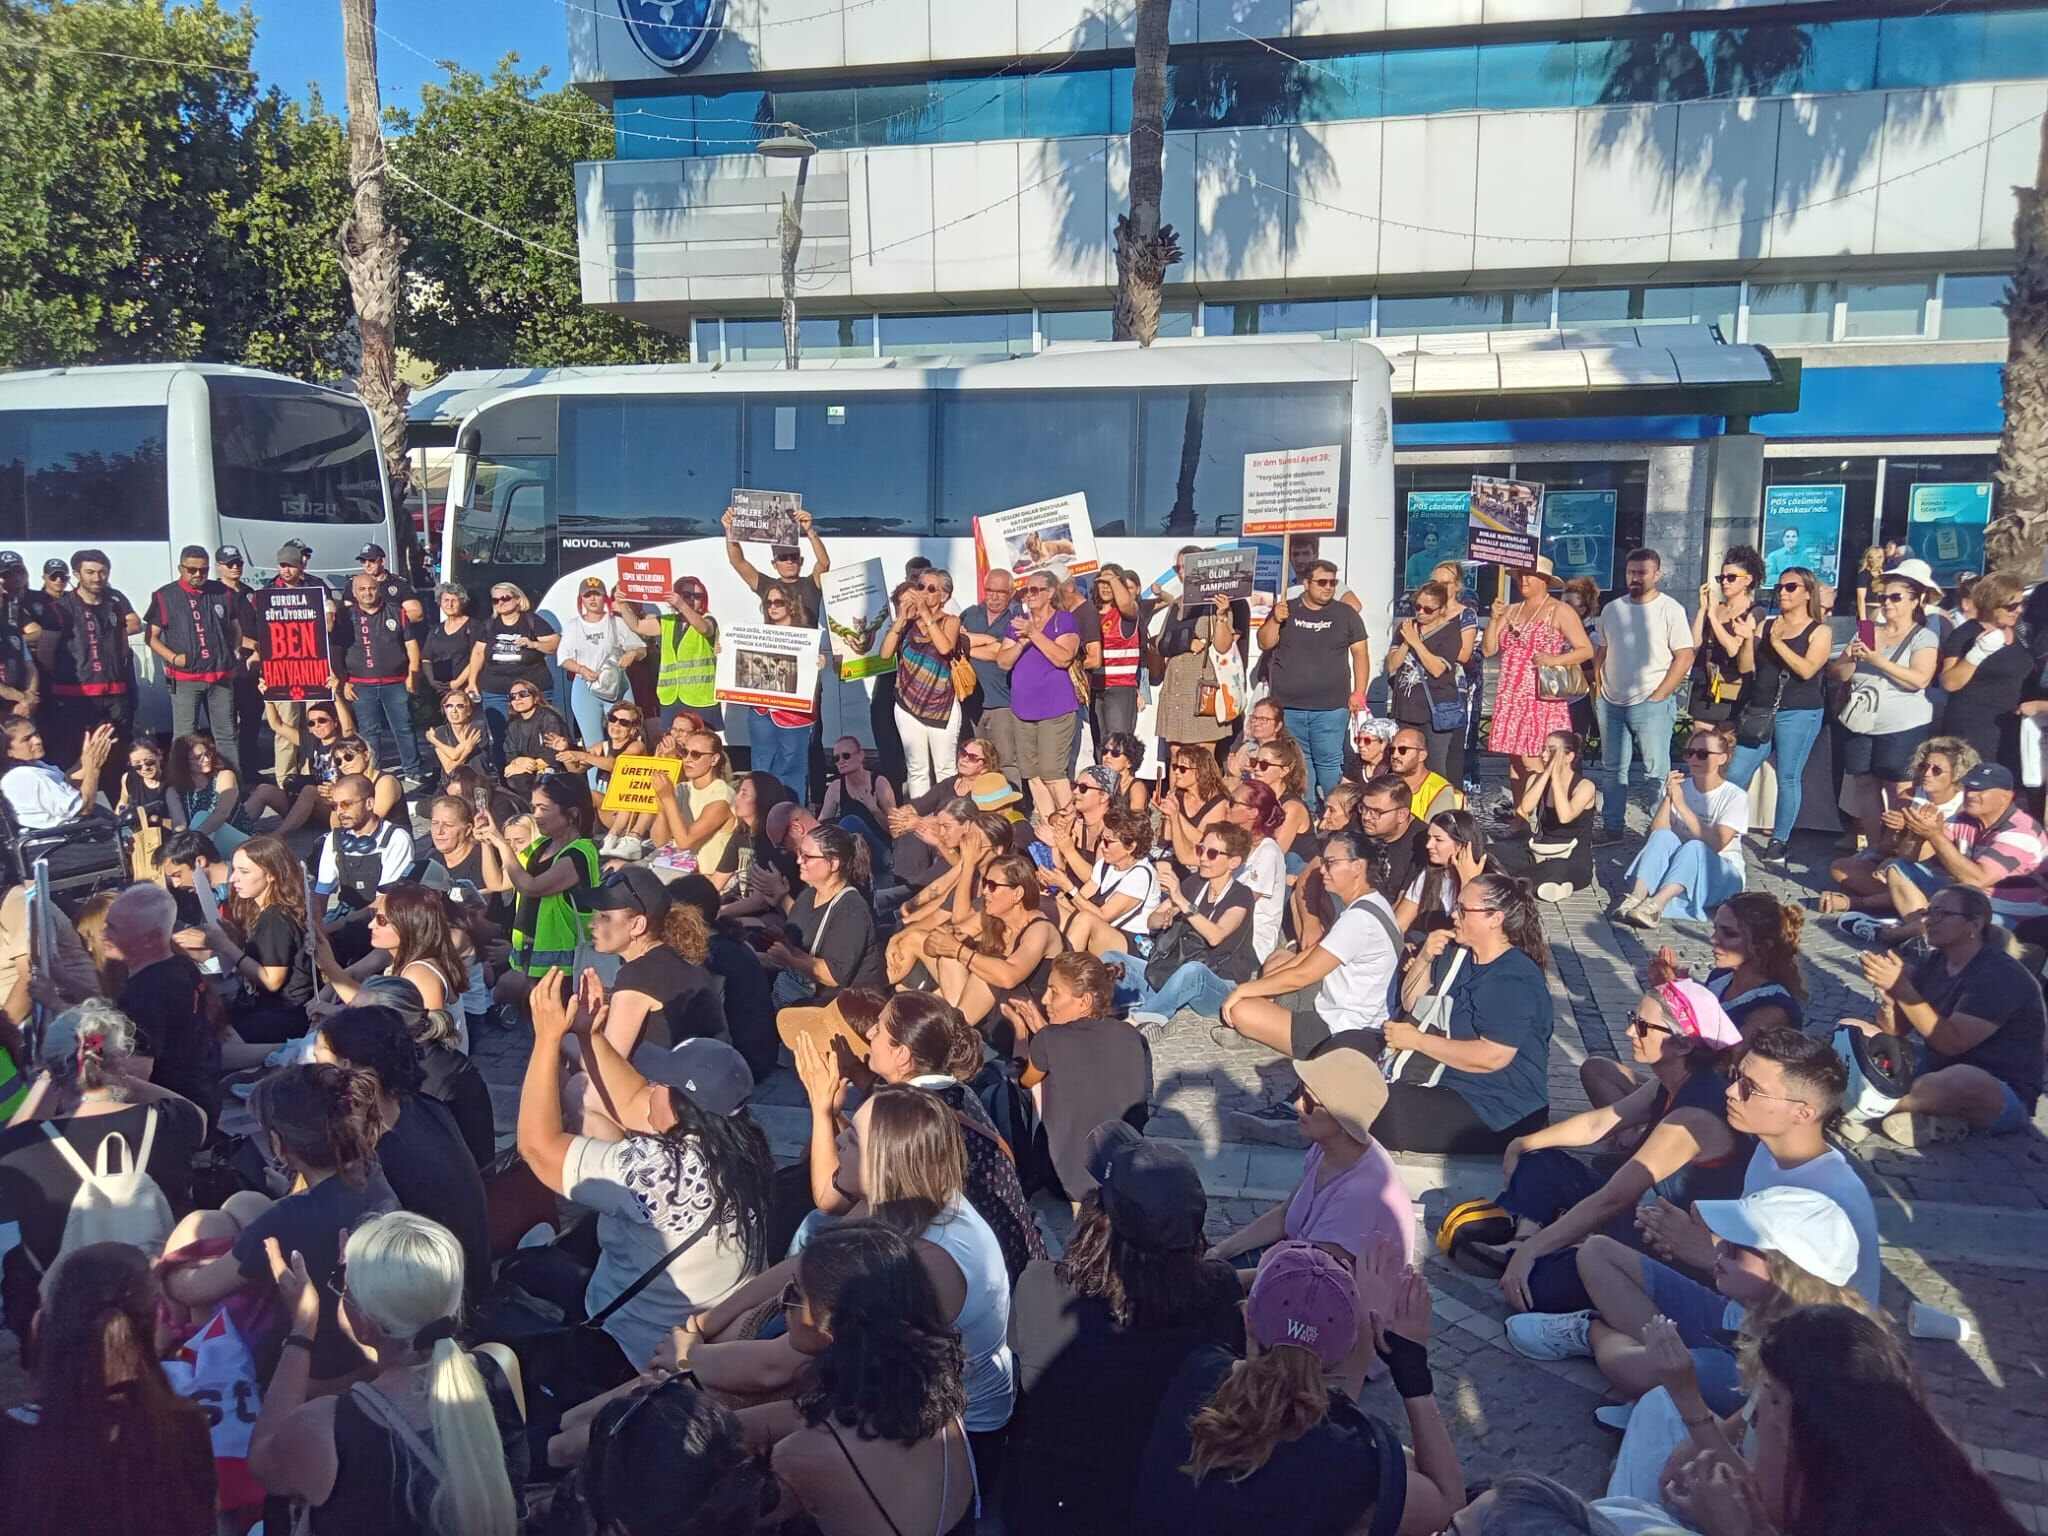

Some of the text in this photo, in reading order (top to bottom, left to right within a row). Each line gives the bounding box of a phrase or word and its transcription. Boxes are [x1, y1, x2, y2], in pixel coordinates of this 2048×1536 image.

[1301, 455, 1318, 465] Ayet
[735, 494, 748, 504] TÜM
[1770, 497, 1827, 506] POS çözümleri
[734, 506, 762, 517] TÜRLERE
[1197, 555, 1243, 568] BARINAKLAR
[1208, 568, 1230, 579] ÖLÜM
[1200, 580, 1239, 592] KAMPIDIR!
[271, 594, 307, 606] GURURLA
[265, 608, 317, 621] SÖYLÜYORUM:
[189, 599, 210, 659] POLİS
[1294, 618, 1333, 632] Wrangler
[269, 621, 318, 659] BEN
[360, 616, 374, 668] POLİS
[263, 659, 329, 688] HAYVANIM!
[619, 793, 656, 804] VERME
